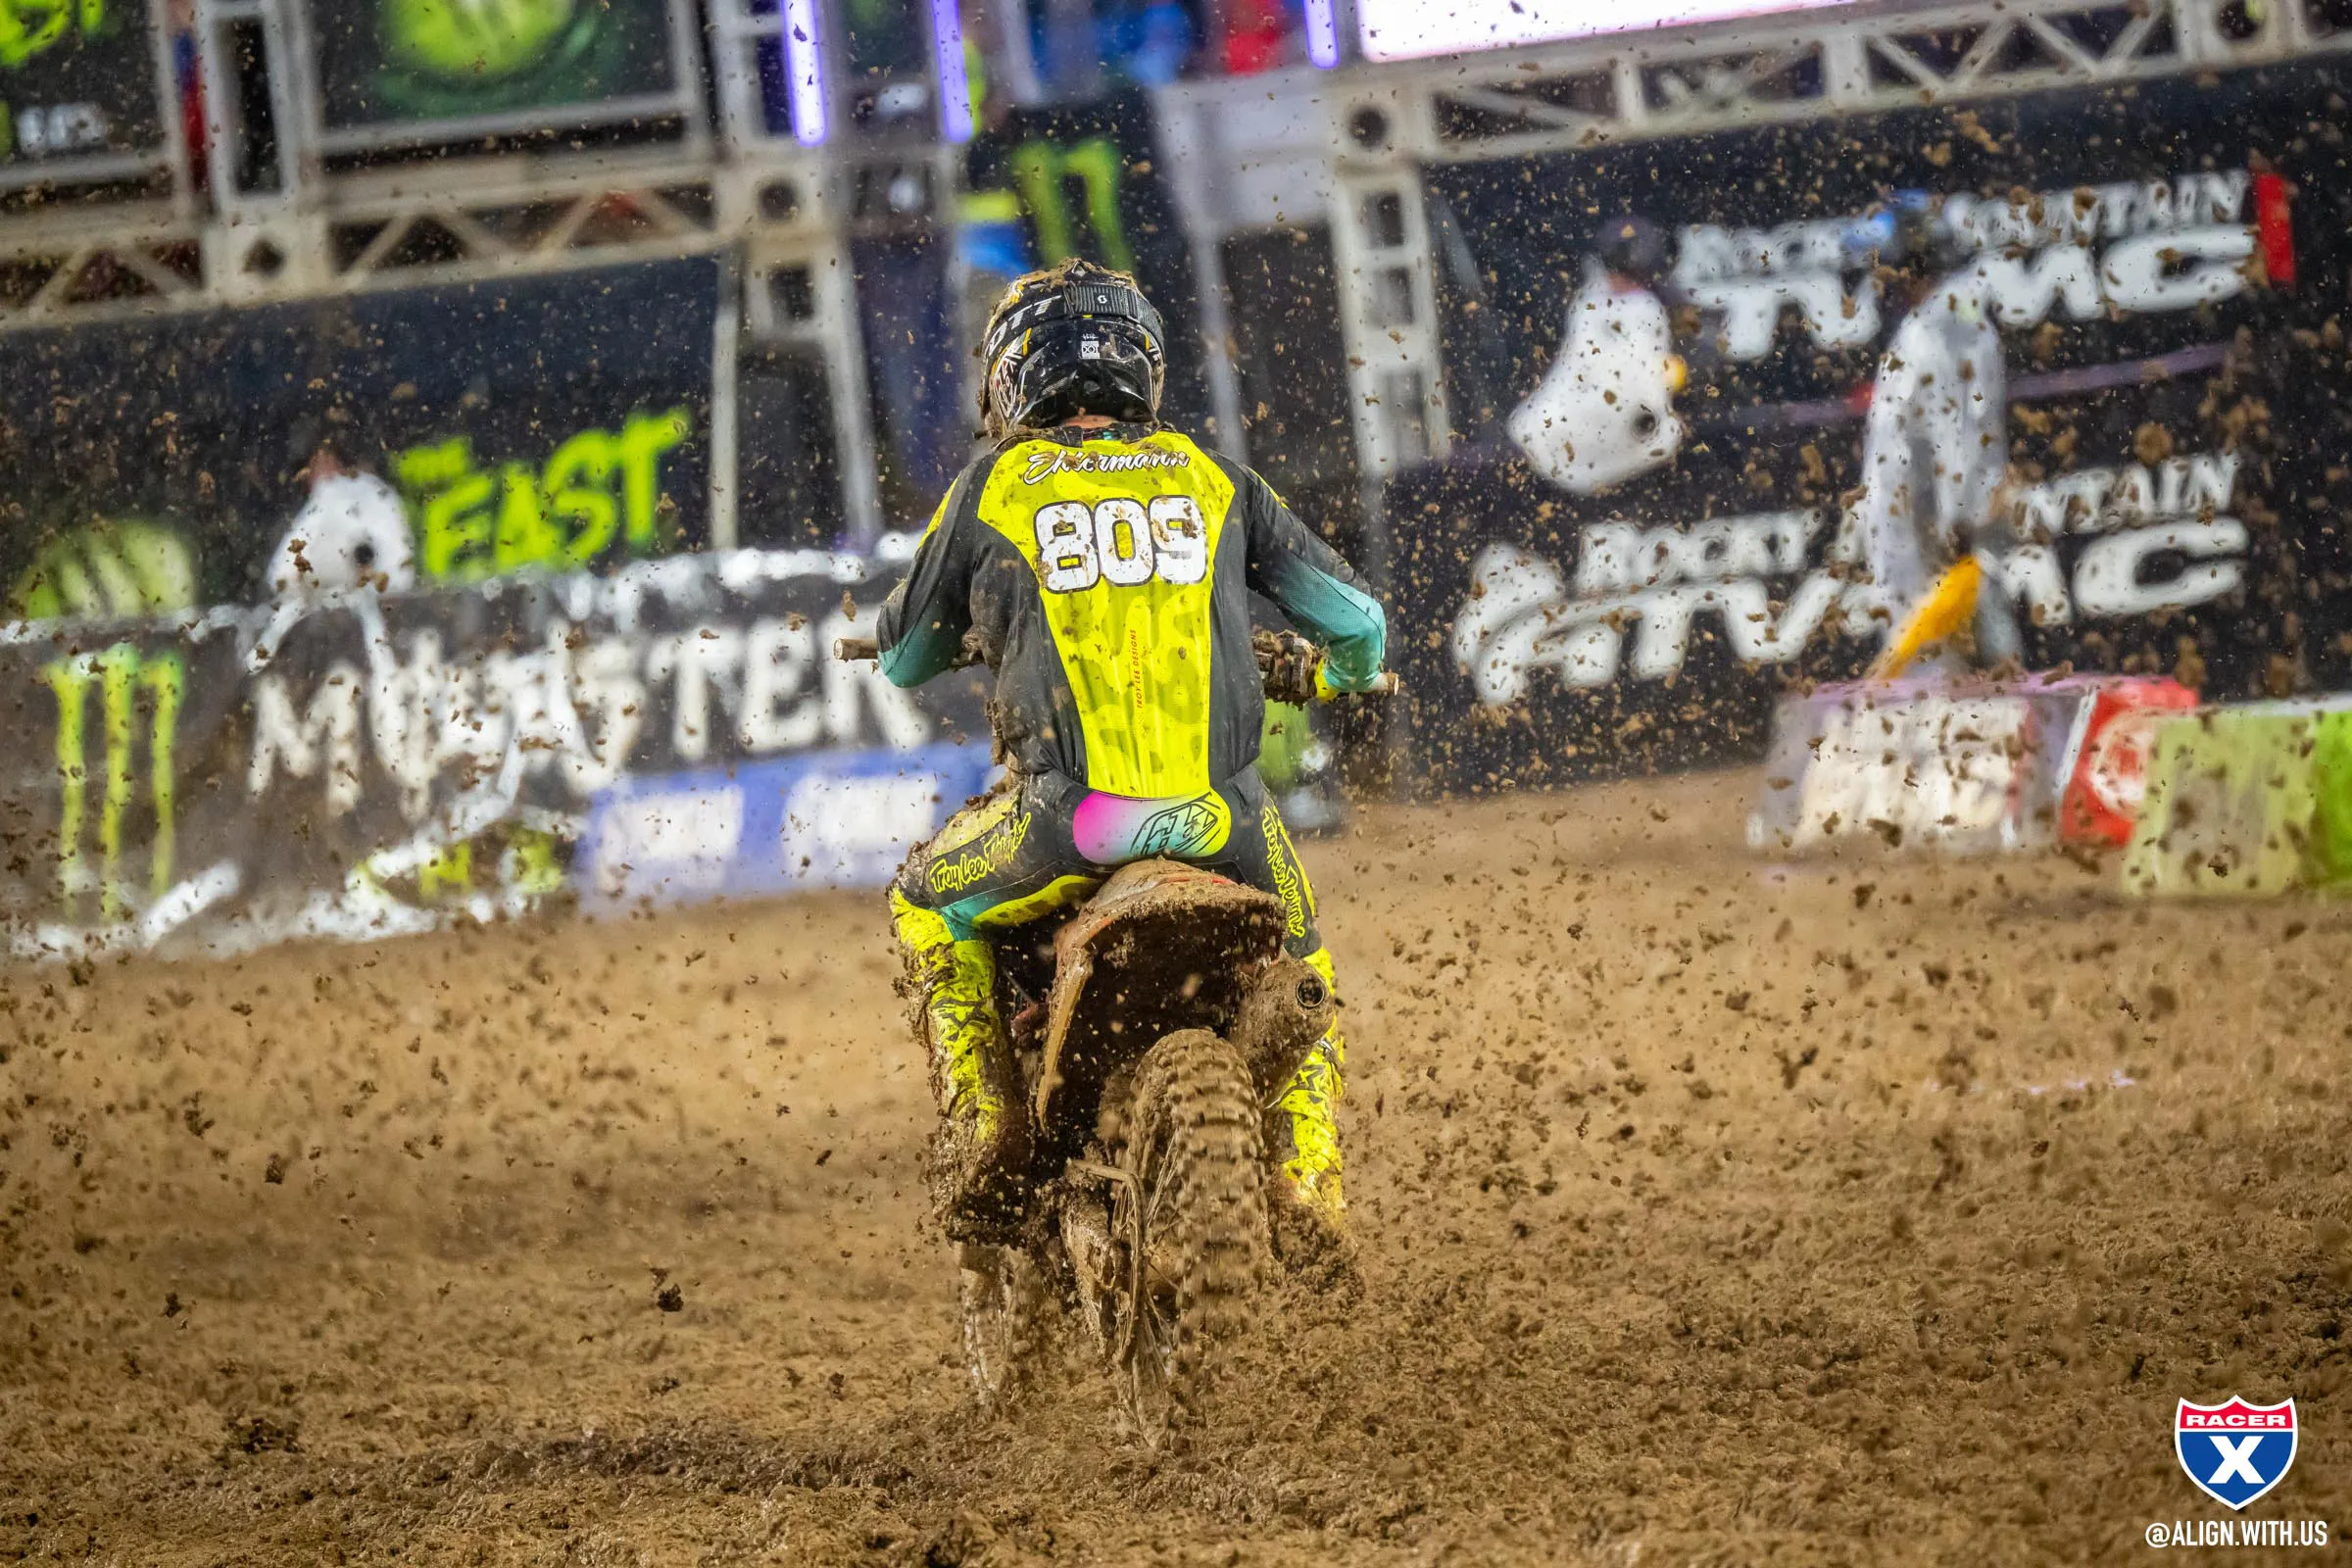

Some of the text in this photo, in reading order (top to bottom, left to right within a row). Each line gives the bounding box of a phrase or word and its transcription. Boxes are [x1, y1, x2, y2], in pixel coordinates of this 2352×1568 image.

[421, 410, 690, 580] EAST
[1034, 495, 1207, 594] 809
[1130, 629, 1139, 666] DESIGNS
